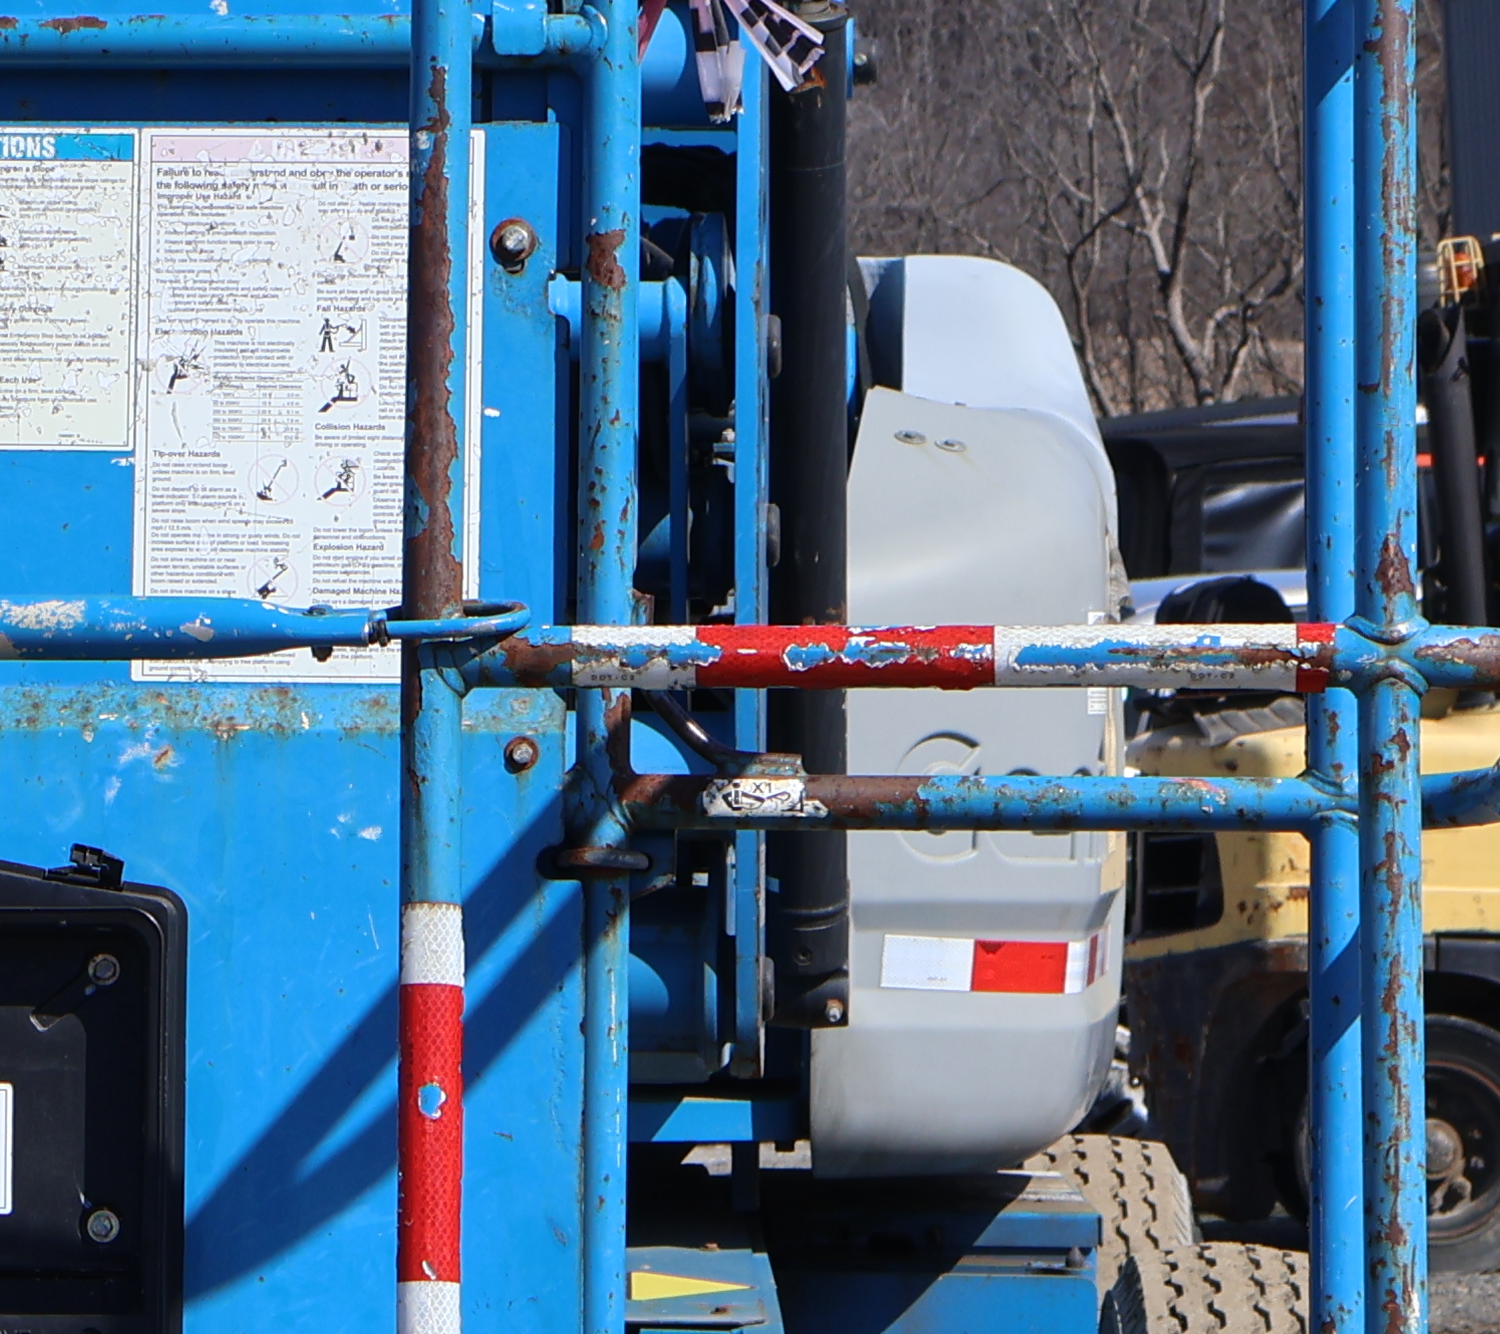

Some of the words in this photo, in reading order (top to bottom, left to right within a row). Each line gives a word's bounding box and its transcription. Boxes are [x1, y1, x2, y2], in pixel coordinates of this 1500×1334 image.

[156, 168, 190, 177] Failure
[192, 169, 202, 177] to
[289, 169, 307, 178] and
[336, 168, 351, 178] the
[354, 169, 403, 179] operator's
[156, 181, 172, 190] the
[174, 181, 218, 192] following
[0, 376, 19, 384] Each
[22, 376, 38, 384] Use
[353, 423, 386, 431] Hazards
[153, 450, 186, 458] Tip-over
[313, 543, 354, 552] Explosion
[356, 543, 384, 551] Hazard
[313, 587, 350, 596] Damaged
[353, 587, 387, 595] Machine
[752, 782, 772, 793] X1
